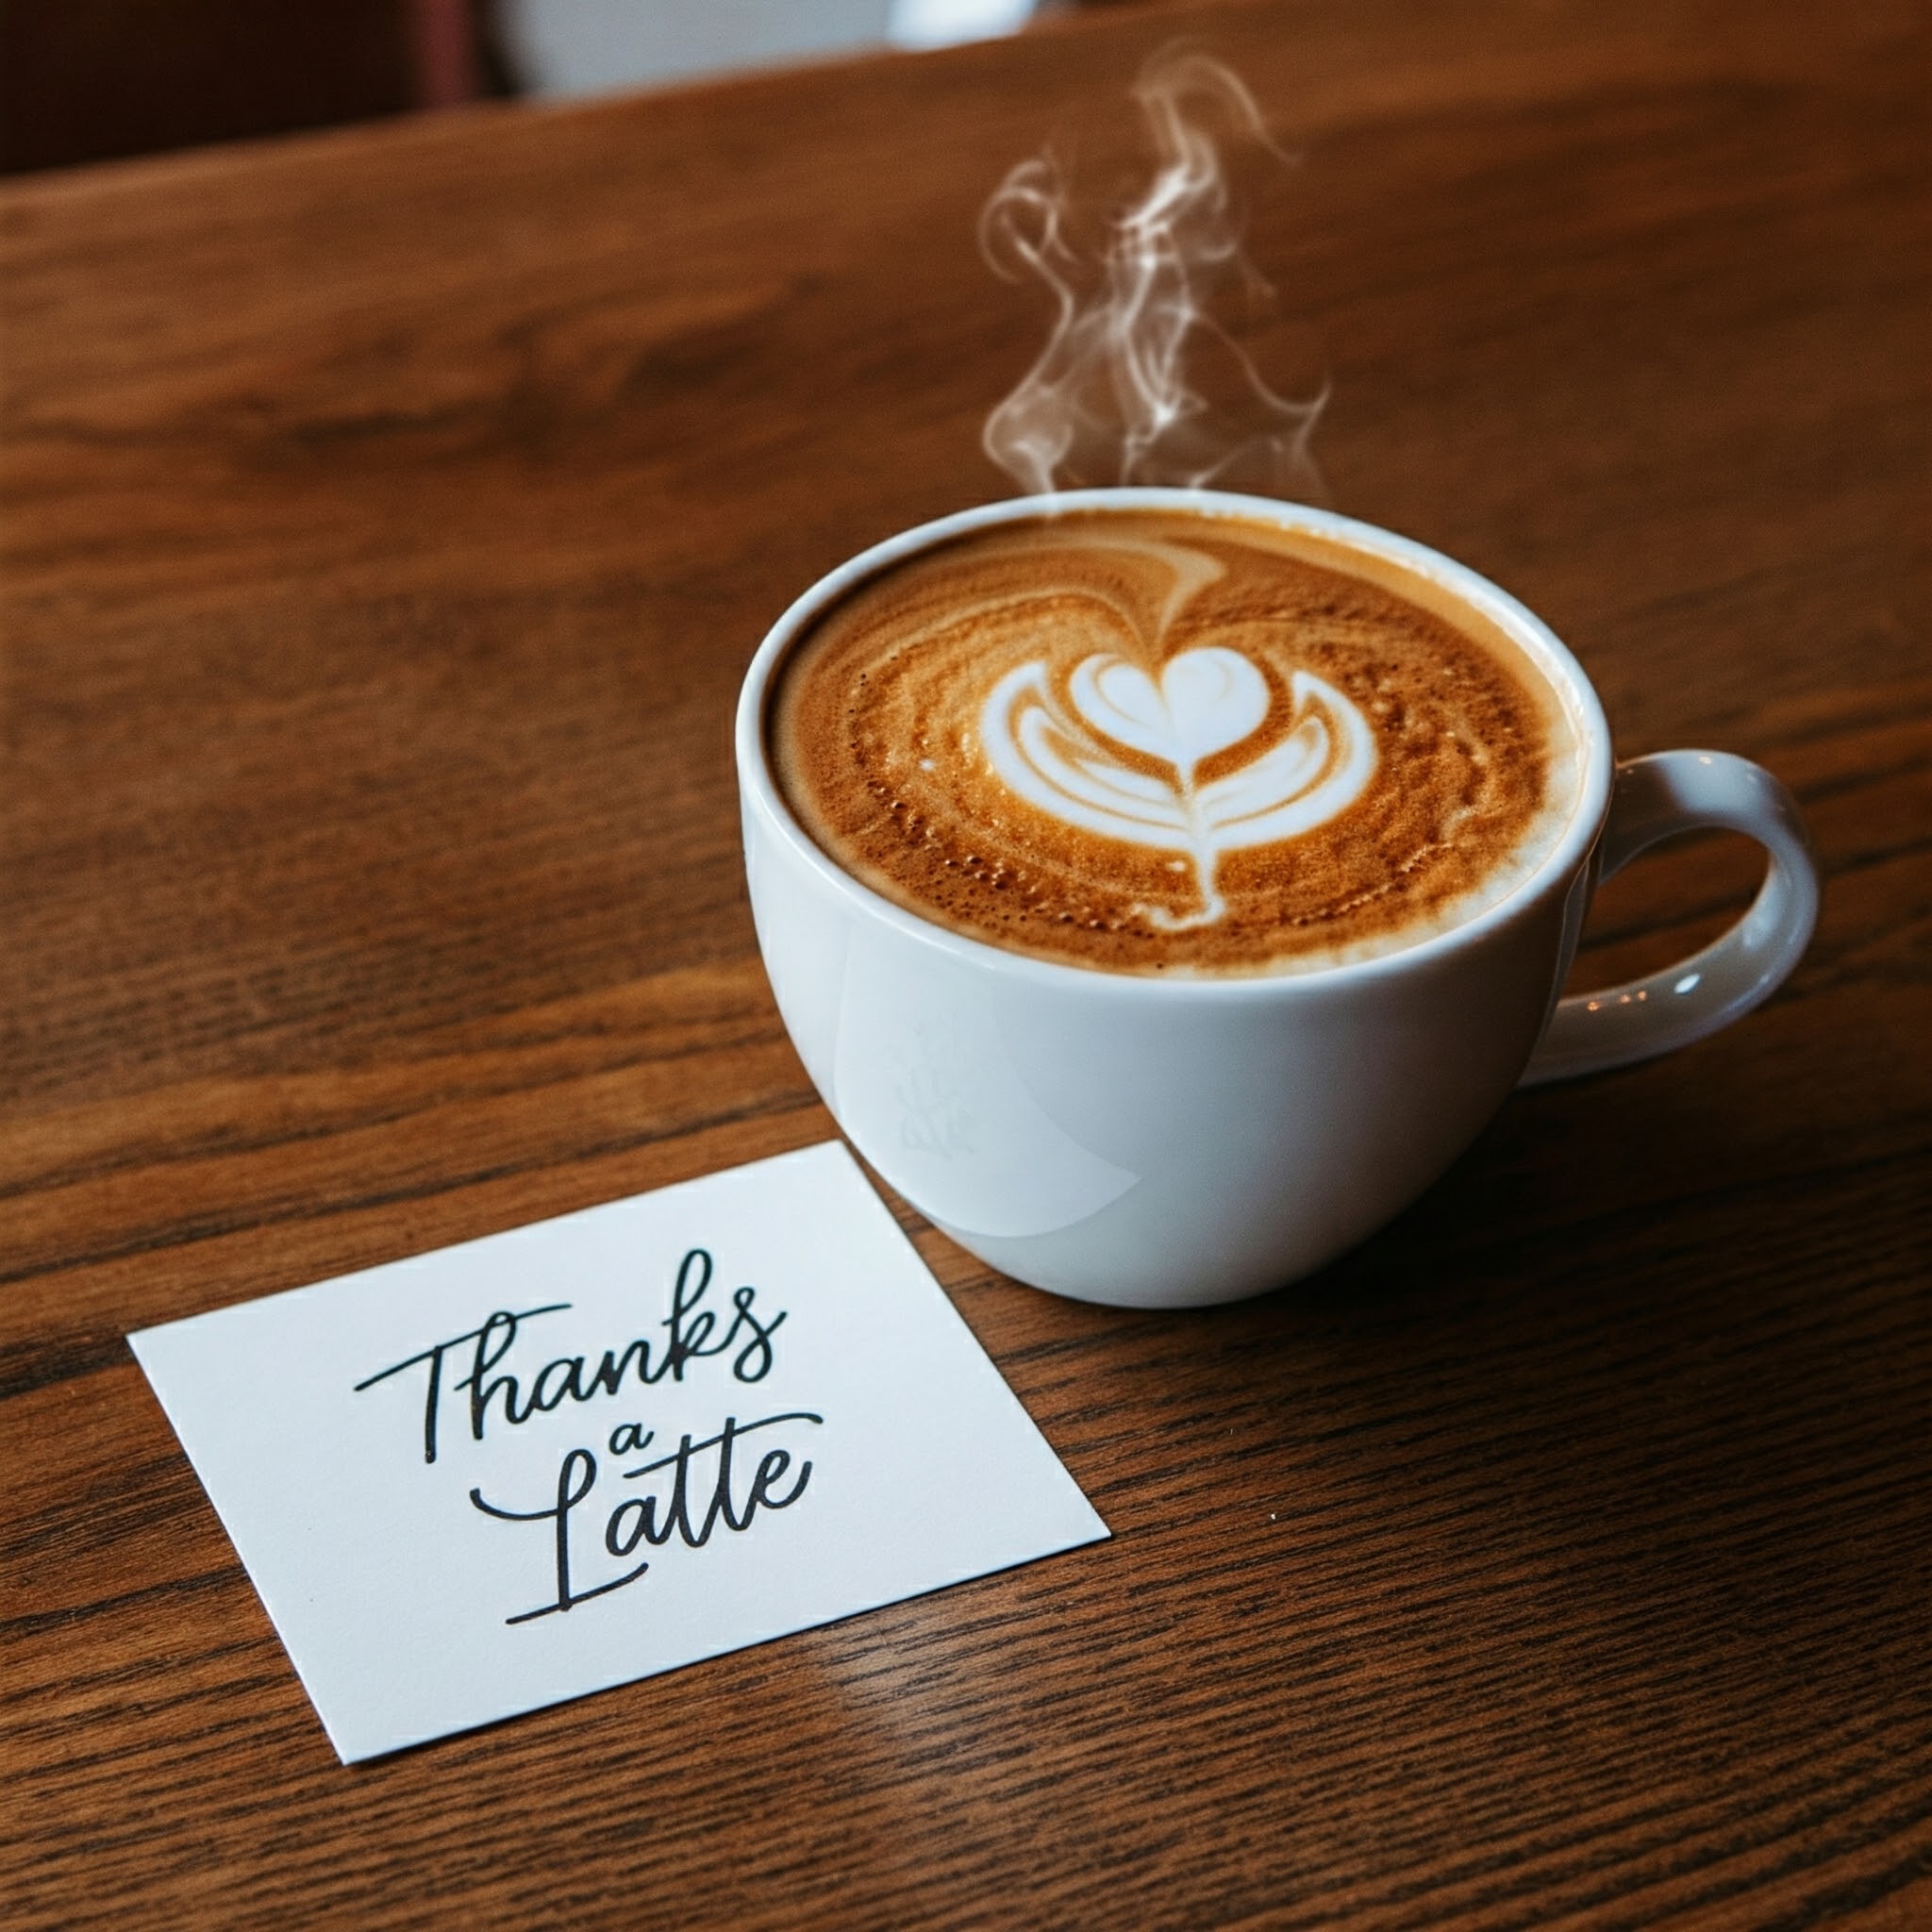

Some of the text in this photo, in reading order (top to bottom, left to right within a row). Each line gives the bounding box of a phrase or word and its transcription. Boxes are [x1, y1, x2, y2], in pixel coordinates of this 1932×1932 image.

[354, 1249, 787, 1464] Thanks
[609, 1424, 654, 1456] a
[470, 1413, 823, 1624] Latte
